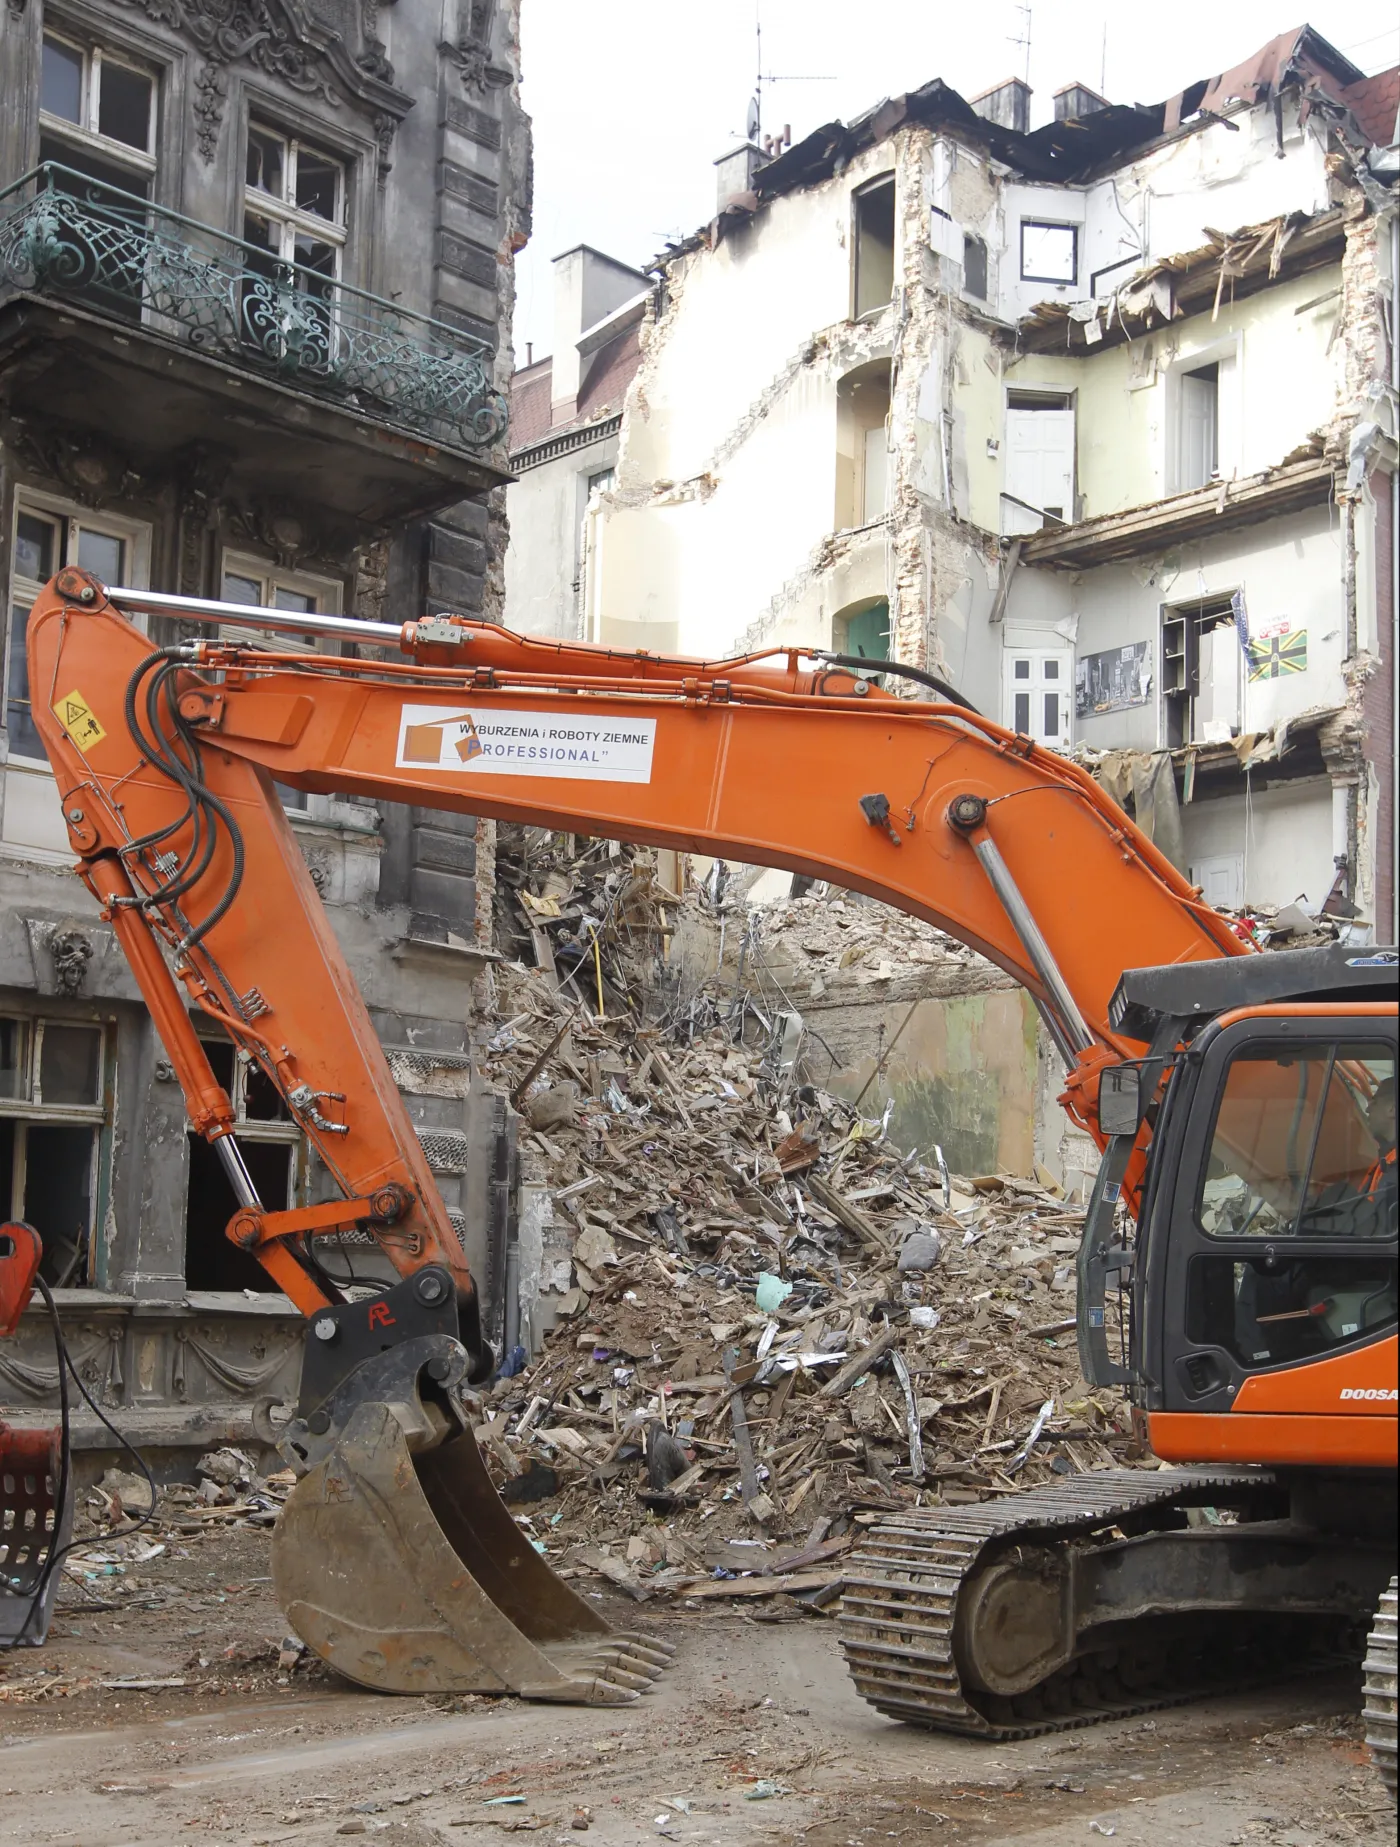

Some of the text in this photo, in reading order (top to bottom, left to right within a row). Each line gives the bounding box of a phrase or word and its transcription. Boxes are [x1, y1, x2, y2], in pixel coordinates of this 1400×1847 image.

[459, 724, 649, 745] WYBURZENIA i ROBOTY ZIEMNE
